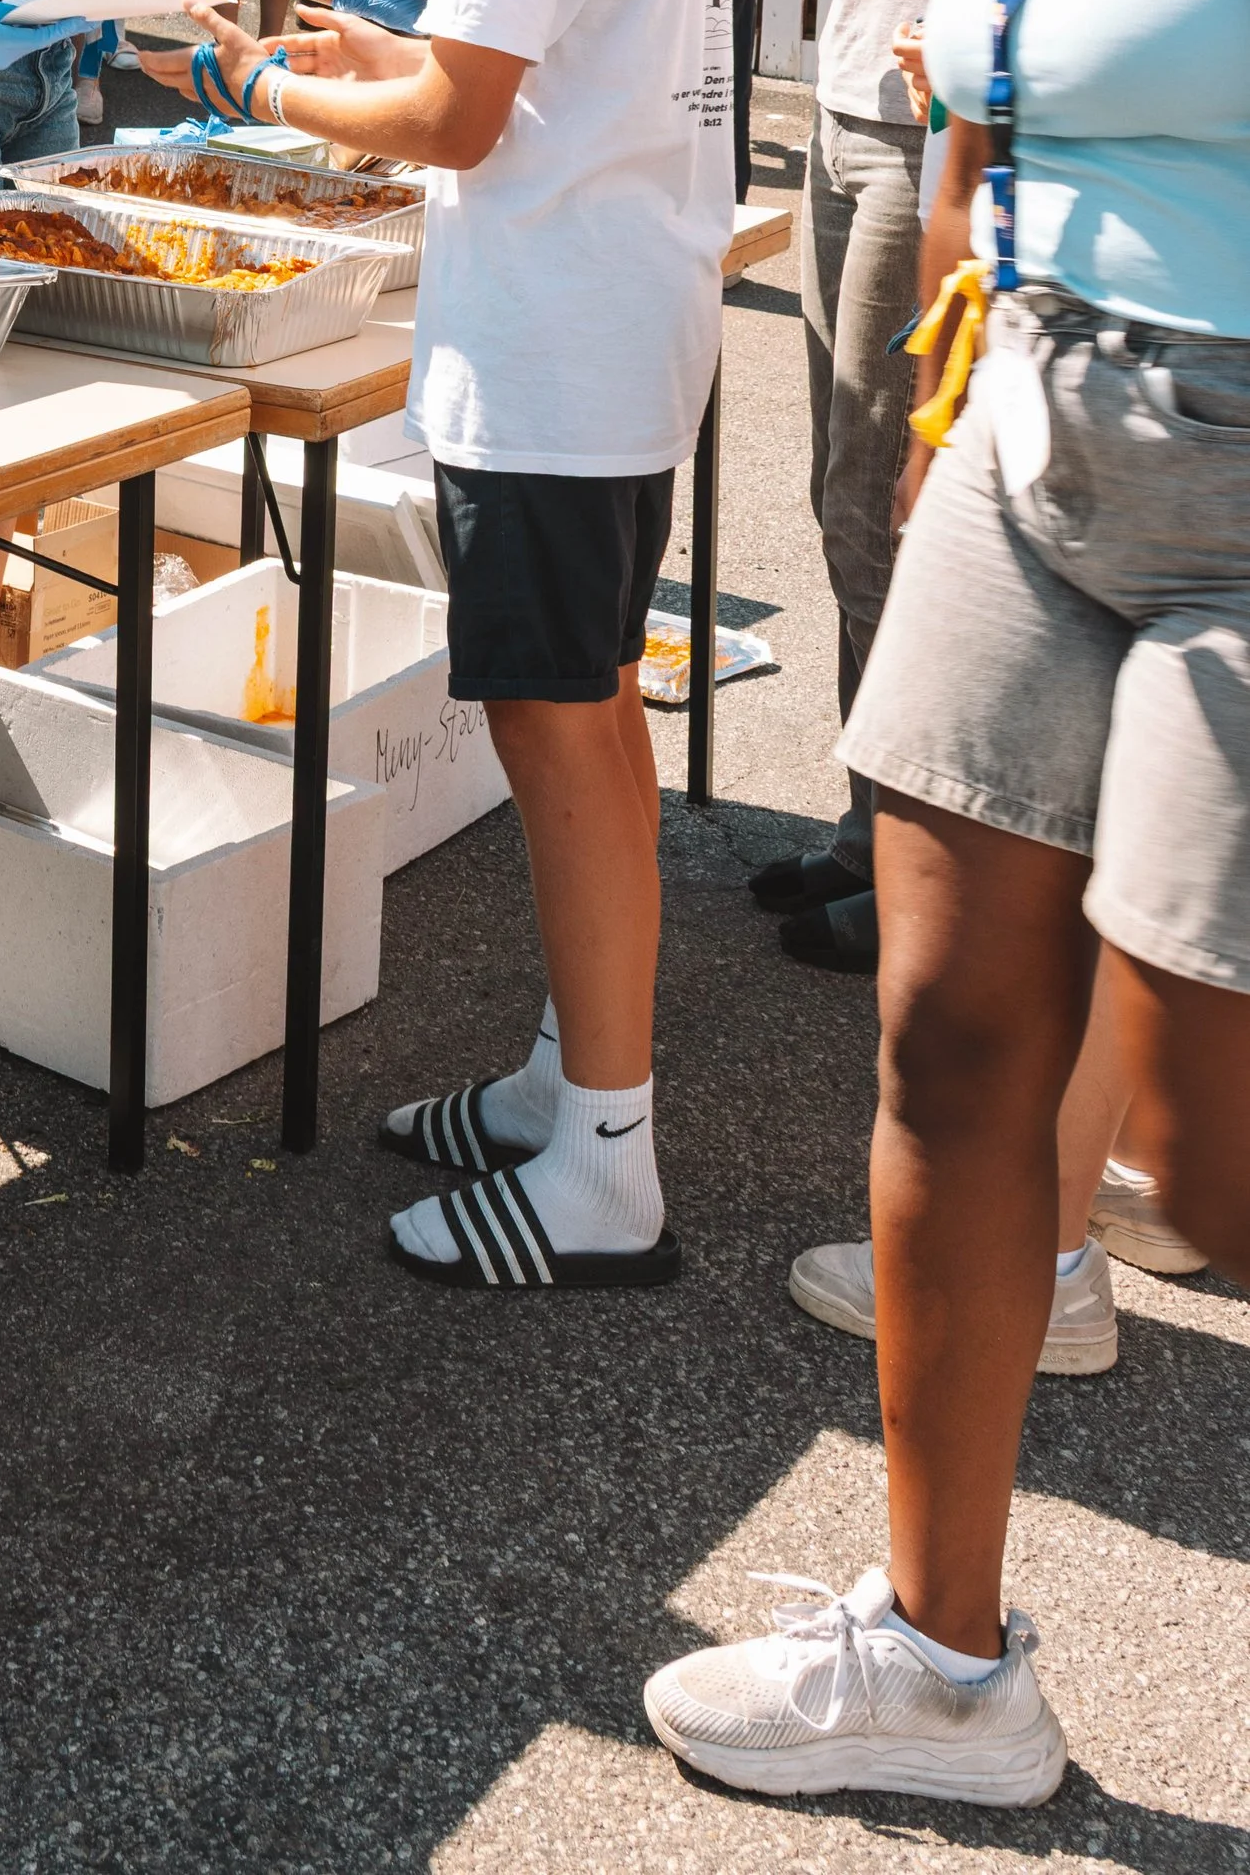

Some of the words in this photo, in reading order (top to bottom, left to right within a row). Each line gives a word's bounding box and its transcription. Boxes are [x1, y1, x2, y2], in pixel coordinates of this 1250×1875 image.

[704, 75, 725, 85] Den
[681, 90, 691, 99] er
[701, 103, 728, 113] livets
[703, 118, 722, 127] 8:12
